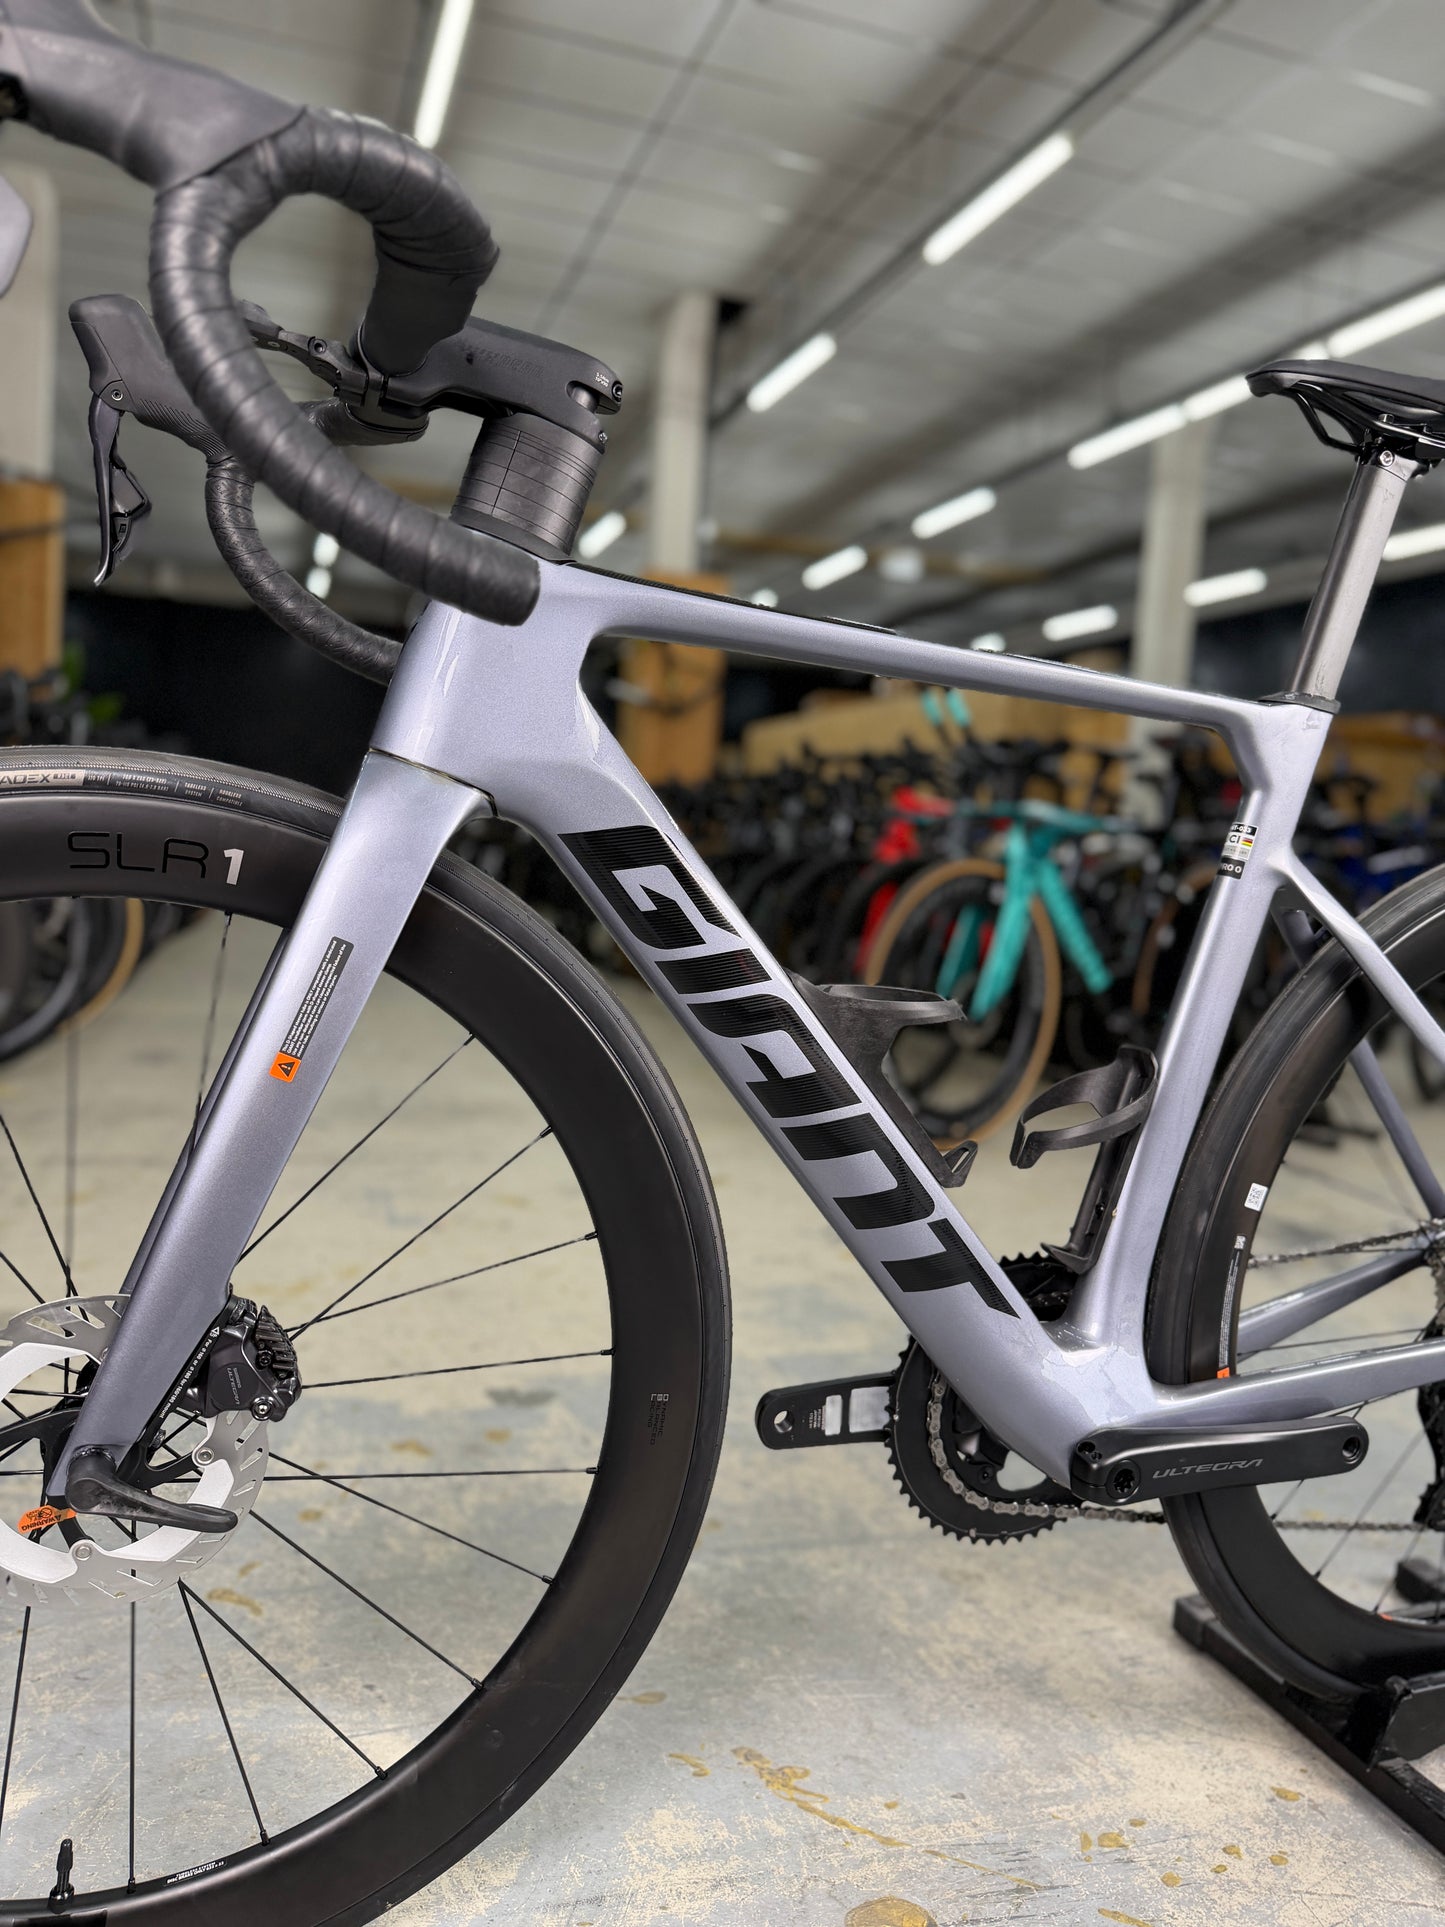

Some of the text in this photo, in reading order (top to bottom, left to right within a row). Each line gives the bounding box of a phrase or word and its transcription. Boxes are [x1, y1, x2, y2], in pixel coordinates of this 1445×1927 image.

[0, 773, 51, 785] ADEX
[67, 831, 244, 885] SLR 1
[557, 825, 1021, 1319] GIANT
[1152, 1458, 1263, 1479] ULTEGRA
[21, 1516, 56, 1531] WARNING
